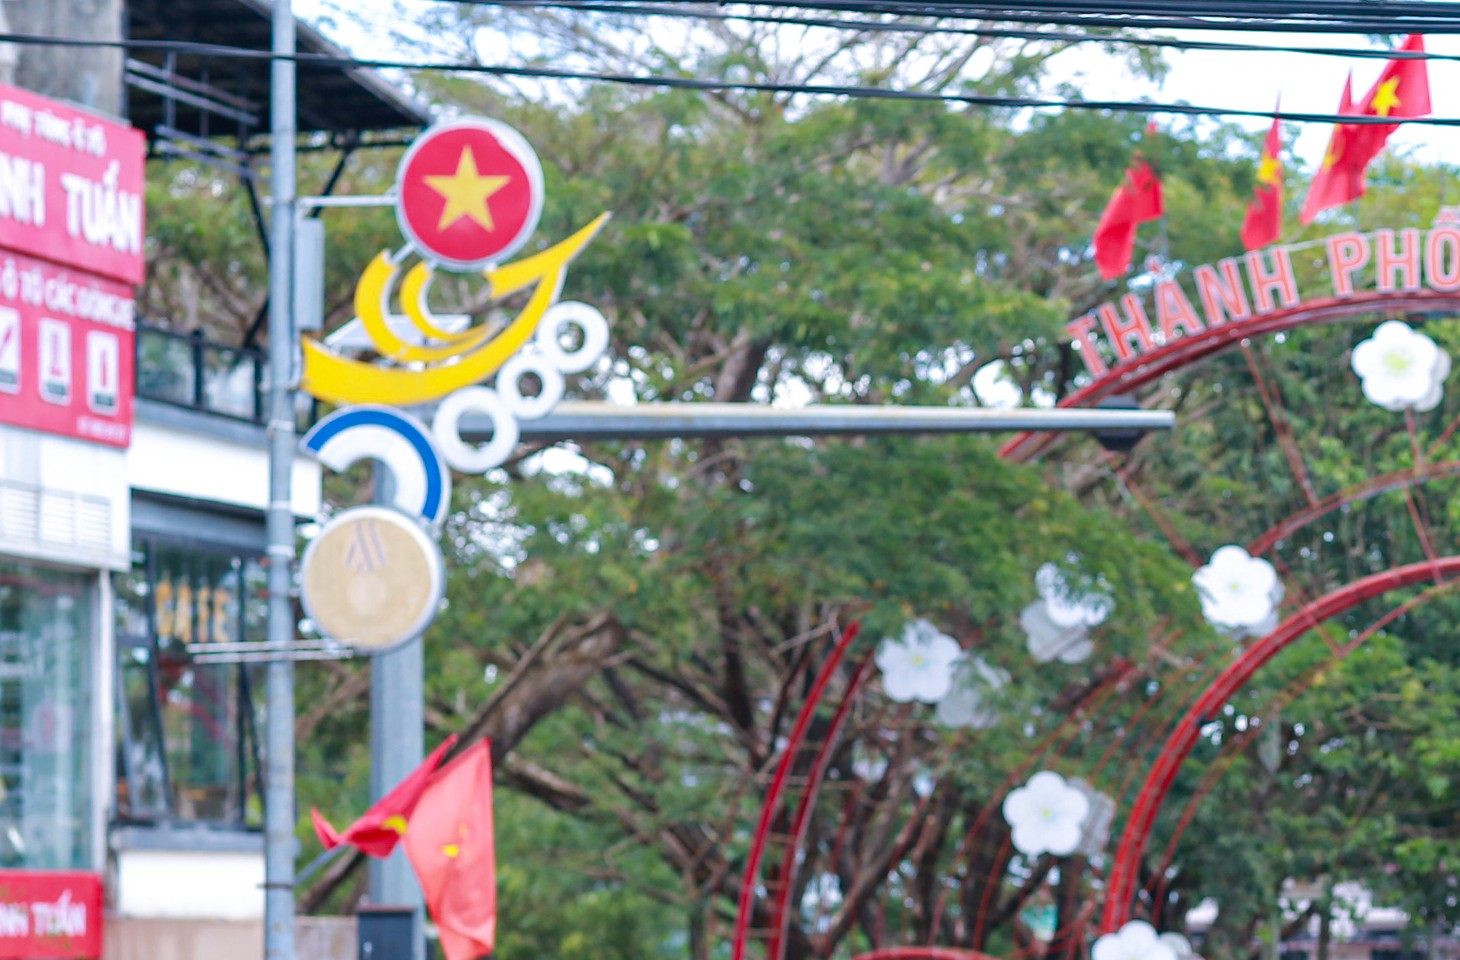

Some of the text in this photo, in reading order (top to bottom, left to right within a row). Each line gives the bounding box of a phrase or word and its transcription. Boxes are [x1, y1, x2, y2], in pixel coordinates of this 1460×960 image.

[60, 159, 141, 256] TUẤN
[1065, 246, 1301, 379] THÀNH
[31, 889, 86, 937] TUẤN
